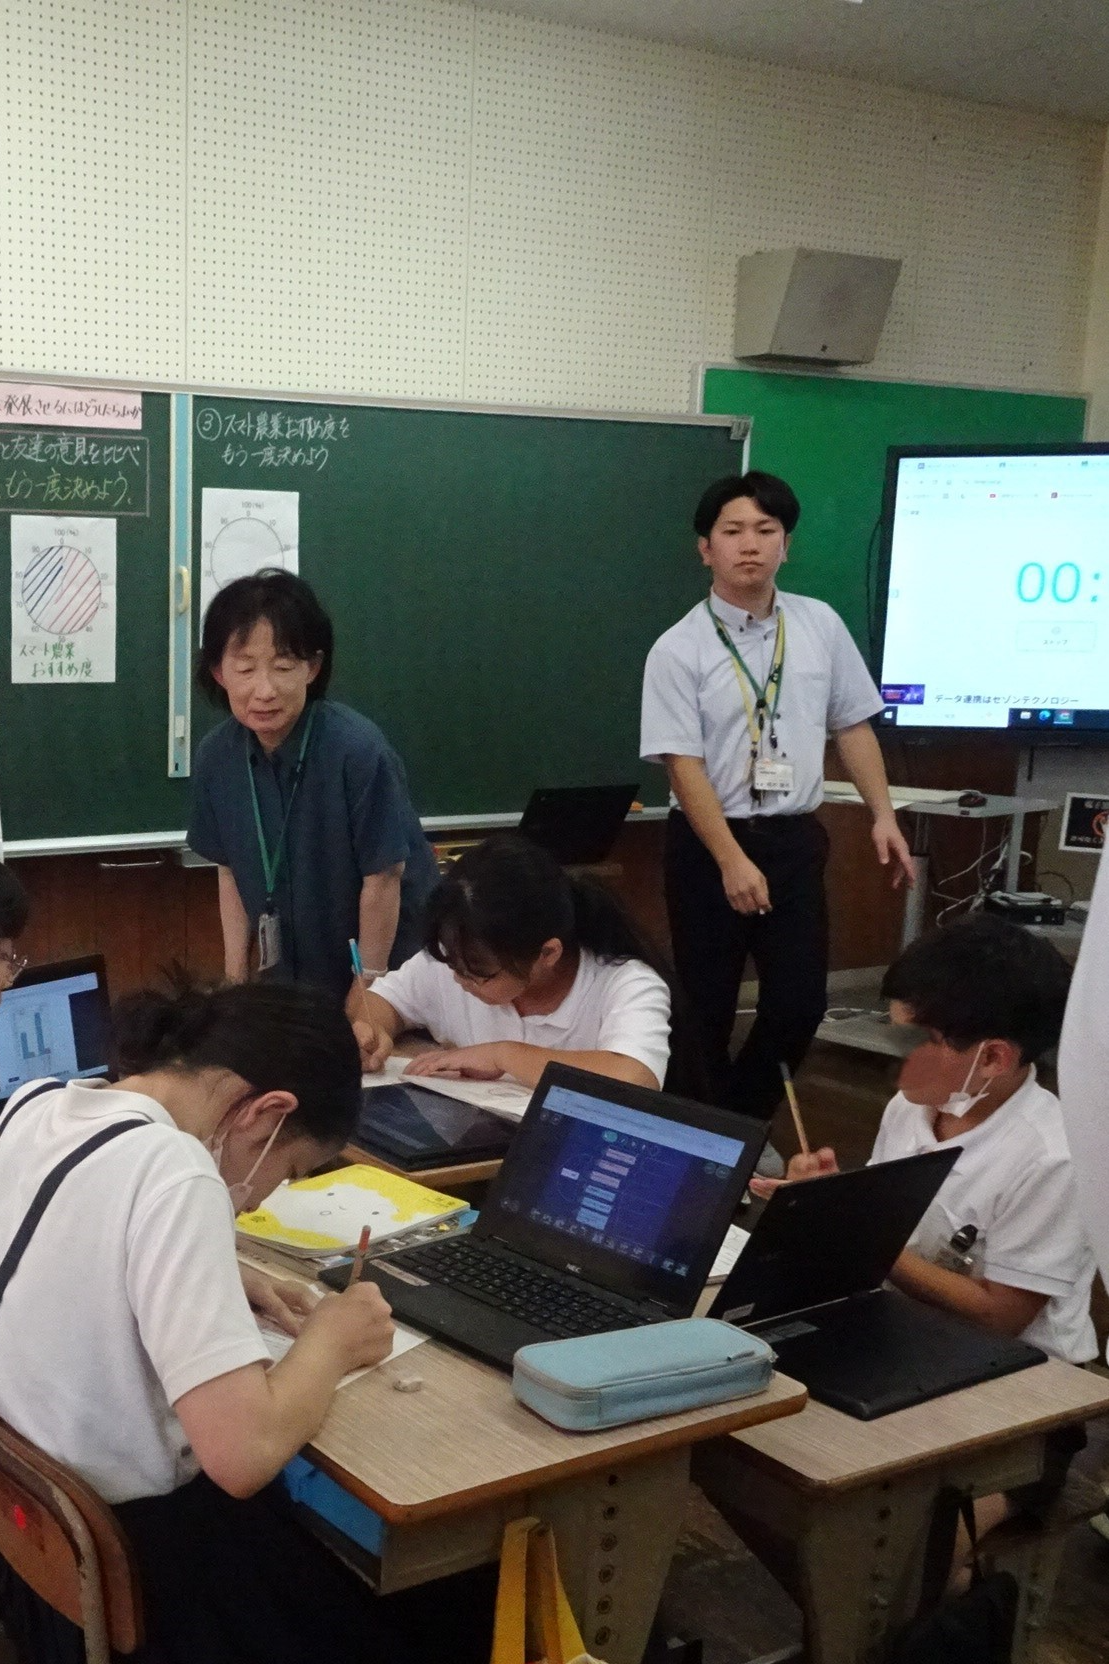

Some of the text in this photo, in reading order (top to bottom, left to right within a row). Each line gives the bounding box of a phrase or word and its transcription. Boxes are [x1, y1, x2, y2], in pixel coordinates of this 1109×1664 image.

[31, 660, 94, 679] おすすめ度
